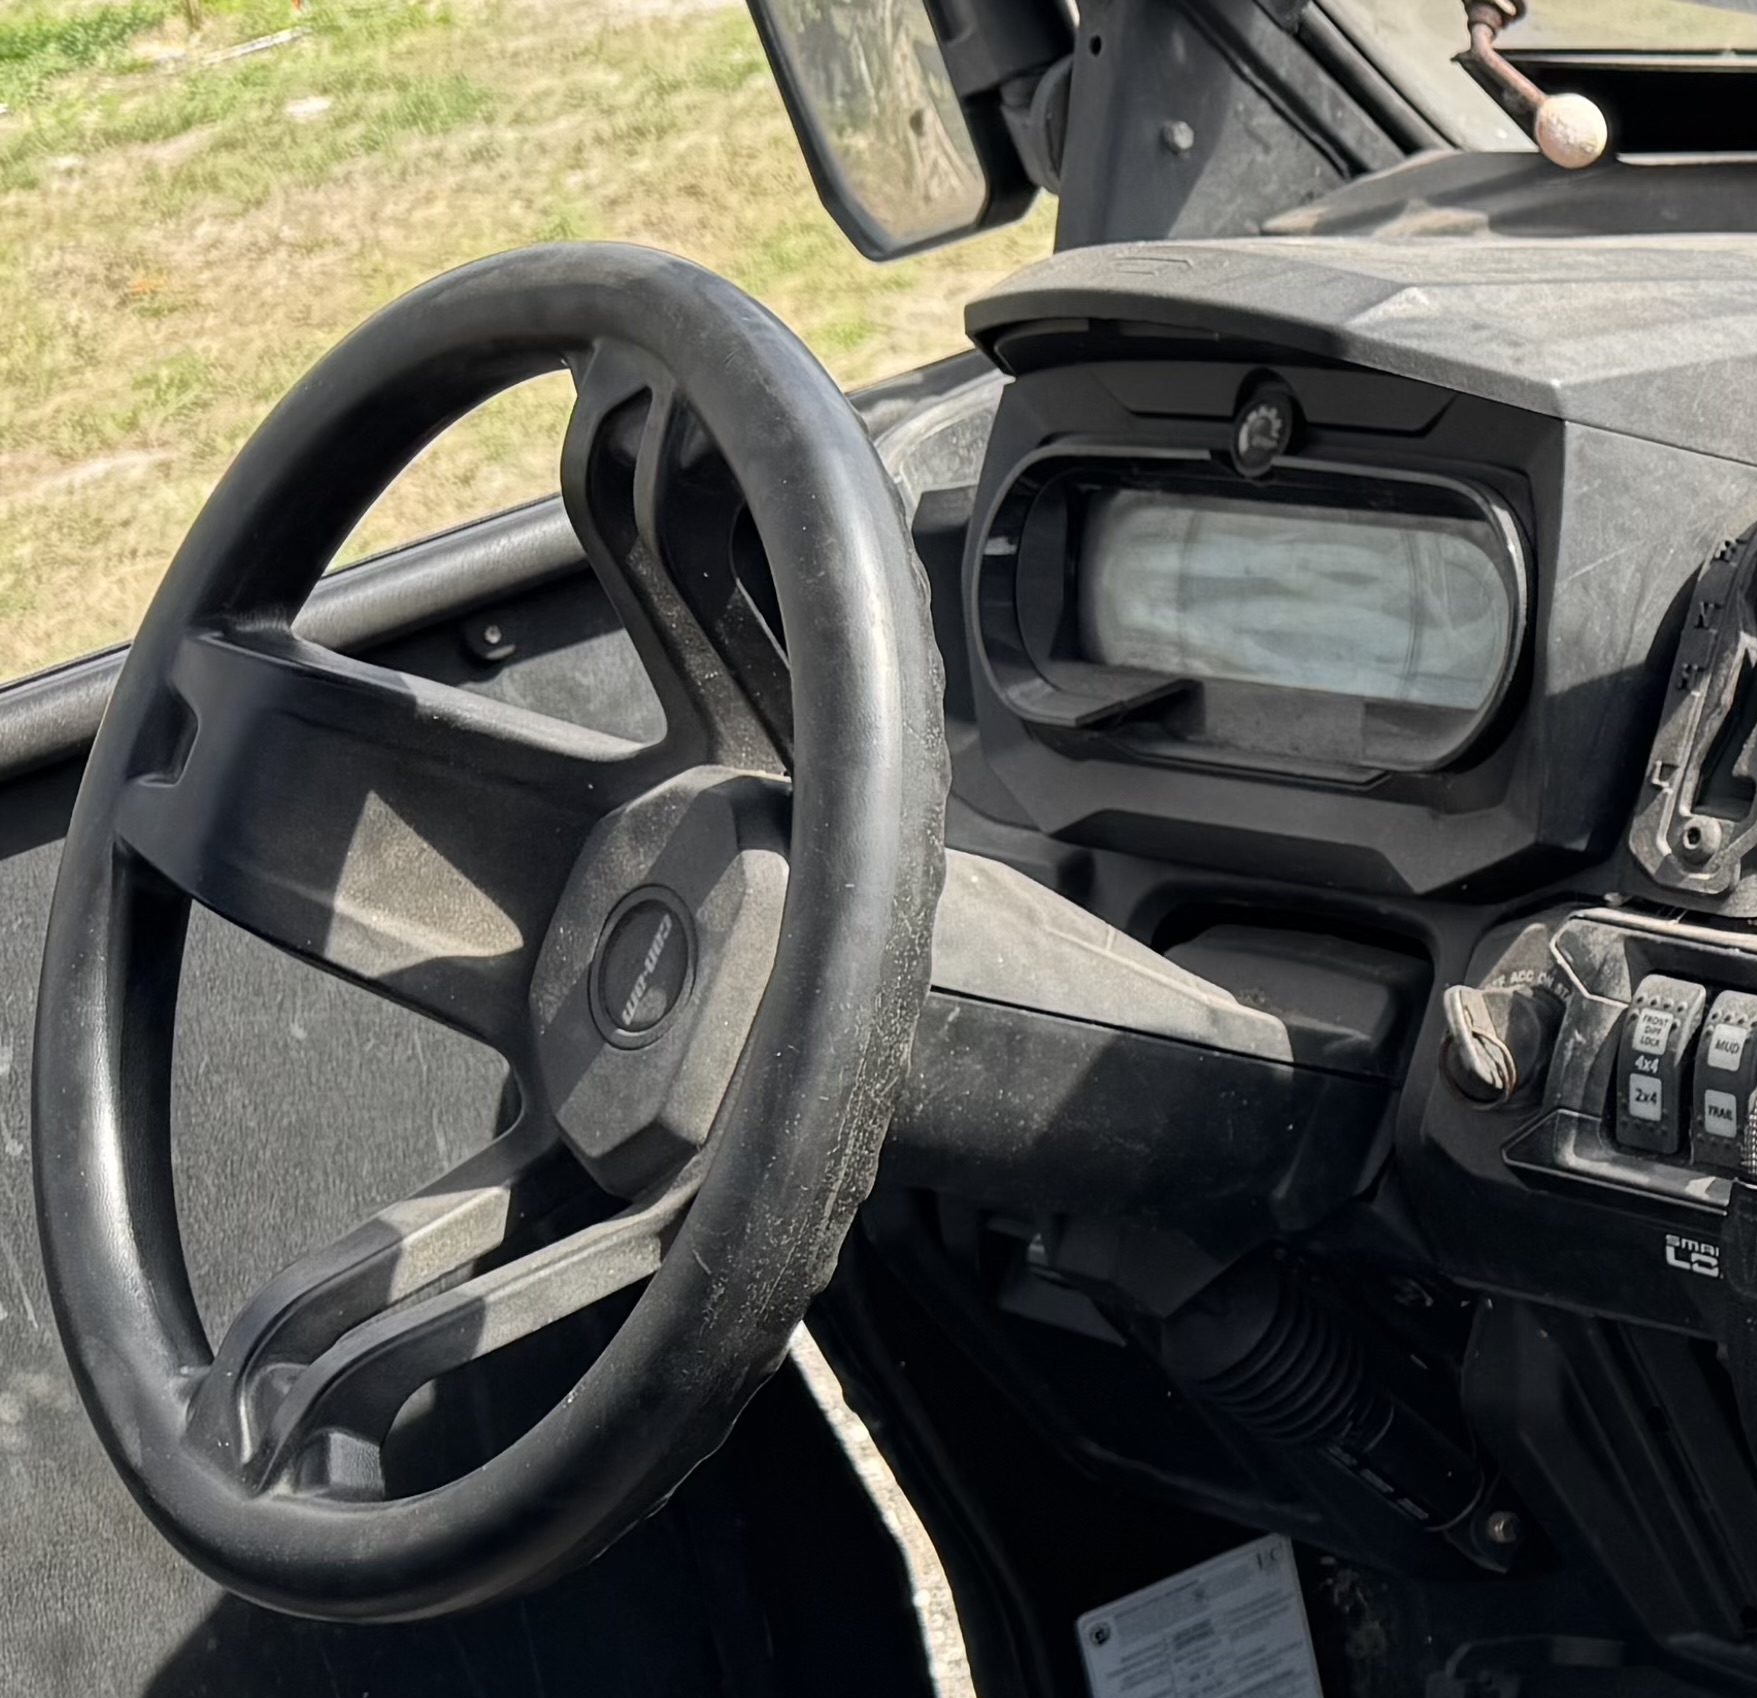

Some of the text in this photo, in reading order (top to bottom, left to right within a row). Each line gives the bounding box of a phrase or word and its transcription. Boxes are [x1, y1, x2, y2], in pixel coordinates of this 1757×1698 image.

[622, 913, 672, 1026] can-am
[1510, 969, 1534, 983] ACC
[1642, 1013, 1669, 1025] FRONT
[1644, 1025, 1662, 1036] DIFF
[1640, 1035, 1661, 1047] LOCK
[1715, 1039, 1740, 1055] MUD
[1634, 1054, 1660, 1075] 4x4
[1635, 1088, 1658, 1105] 2x4
[1708, 1105, 1734, 1121] TRAIL
[1665, 1234, 1719, 1257] SMA
[1665, 1245, 1722, 1279] LO
